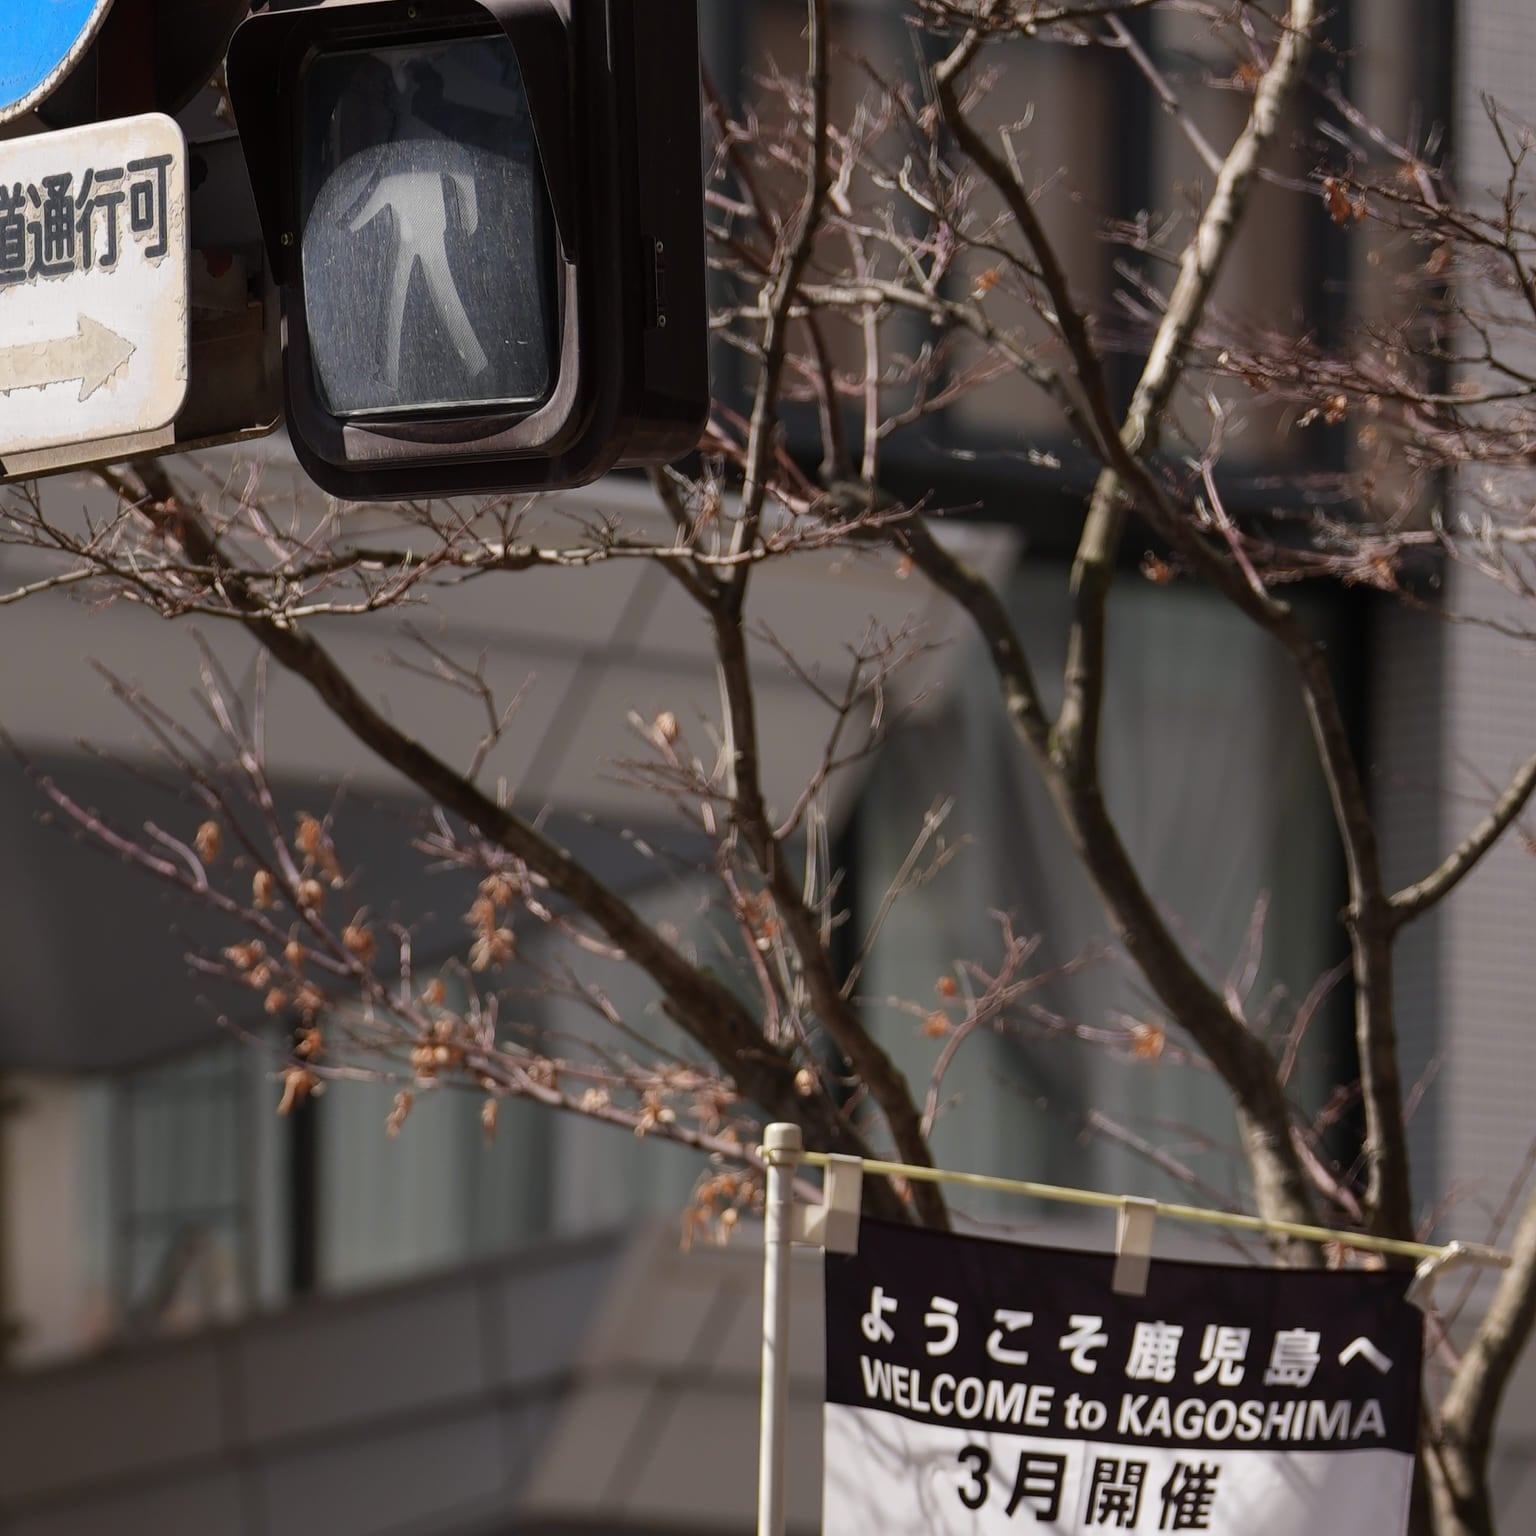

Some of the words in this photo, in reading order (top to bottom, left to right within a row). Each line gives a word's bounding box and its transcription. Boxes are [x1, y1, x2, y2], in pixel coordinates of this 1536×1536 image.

[860, 1285, 1393, 1389] ようこそ鹿児島へ
[860, 1355, 1055, 1427] WELCOME
[1064, 1392, 1107, 1432] to
[1118, 1394, 1387, 1441] KAGOSHIMA
[956, 1445, 1221, 1532] 3月開催
